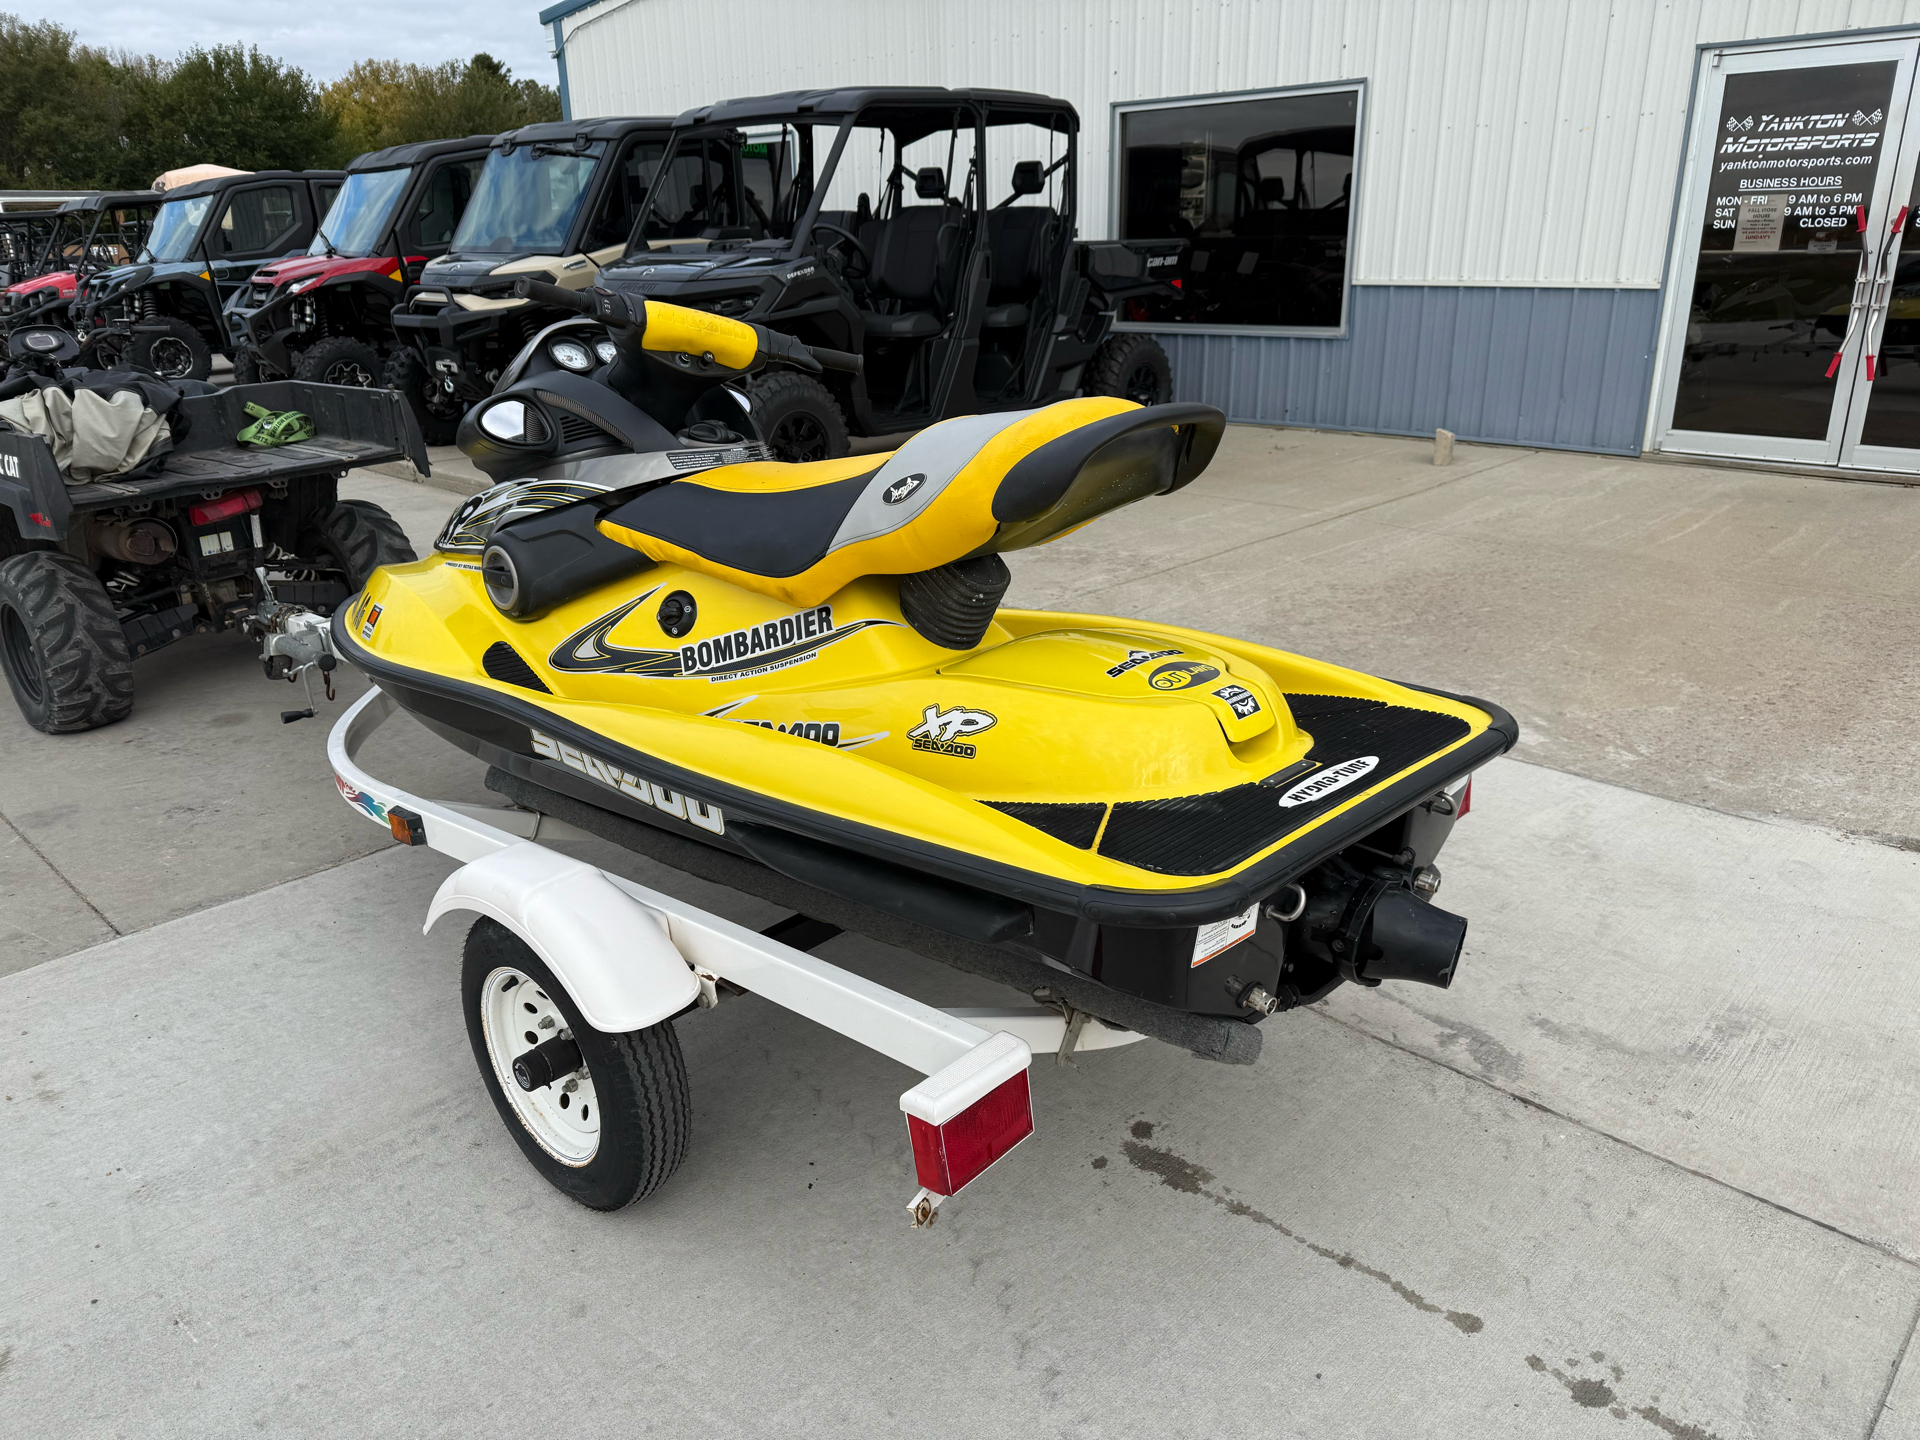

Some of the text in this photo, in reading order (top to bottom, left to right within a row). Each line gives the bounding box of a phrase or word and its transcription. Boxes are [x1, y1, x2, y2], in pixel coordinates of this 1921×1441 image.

[1758, 113, 1850, 132] YANKTON
[1720, 132, 1880, 154] MOTORSPORTS
[1719, 155, 1873, 173] yanktonmotorsports.com
[1739, 175, 1842, 189] BUSINESS HOURS
[1716, 196, 1742, 206] MON
[1750, 195, 1768, 205] FRI
[1788, 194, 1796, 205] 9
[1798, 194, 1817, 204] AM
[1820, 194, 1831, 204] to
[1834, 193, 1842, 203] 6
[1844, 193, 1862, 203] PM
[1714, 205, 1857, 217] SAT 9 AM to 5 PM
[1712, 217, 1848, 229] SUN CLOSED
[786, 266, 815, 280] DEFENDER
[4, 454, 20, 478] CAT
[681, 605, 834, 673] BOMBARDIER
[711, 652, 817, 682] DIRECT ACTION SUSPENSION
[907, 703, 997, 742] XP
[1287, 759, 1370, 802] HYDRO-TURF
